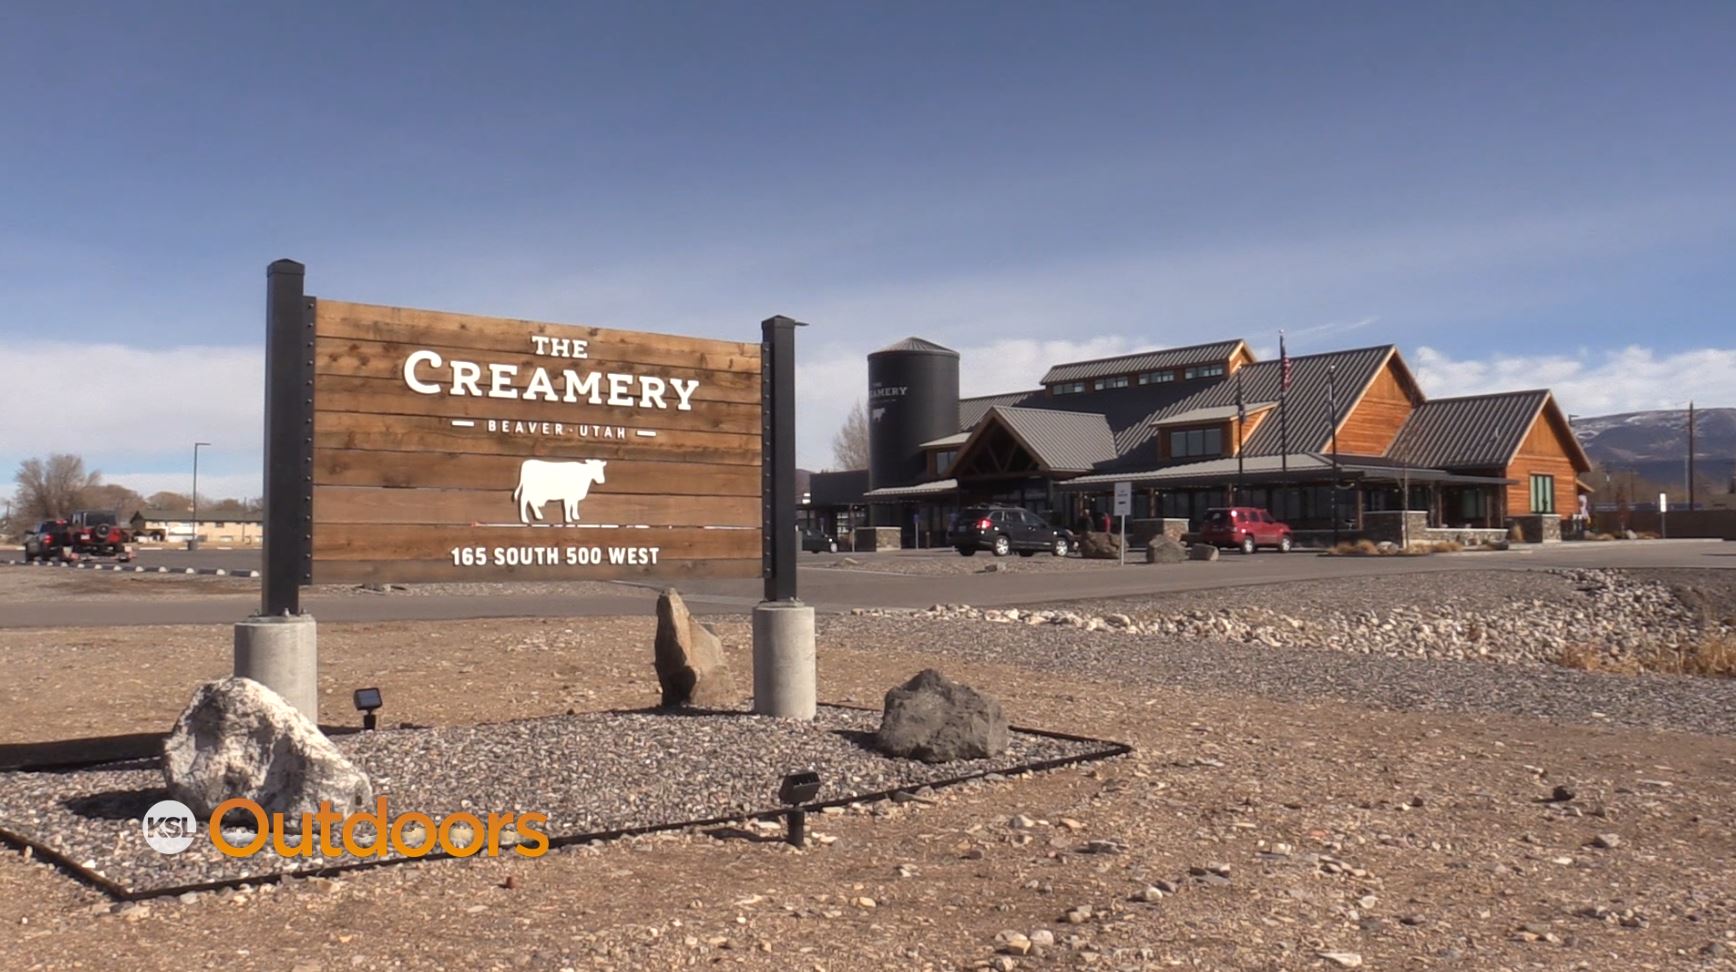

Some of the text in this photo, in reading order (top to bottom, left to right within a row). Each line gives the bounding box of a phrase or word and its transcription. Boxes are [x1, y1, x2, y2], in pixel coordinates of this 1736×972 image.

[531, 335, 588, 359] THE
[403, 350, 699, 410] CREAMERY
[451, 547, 660, 566] 165 SOUTH 500 WEST
